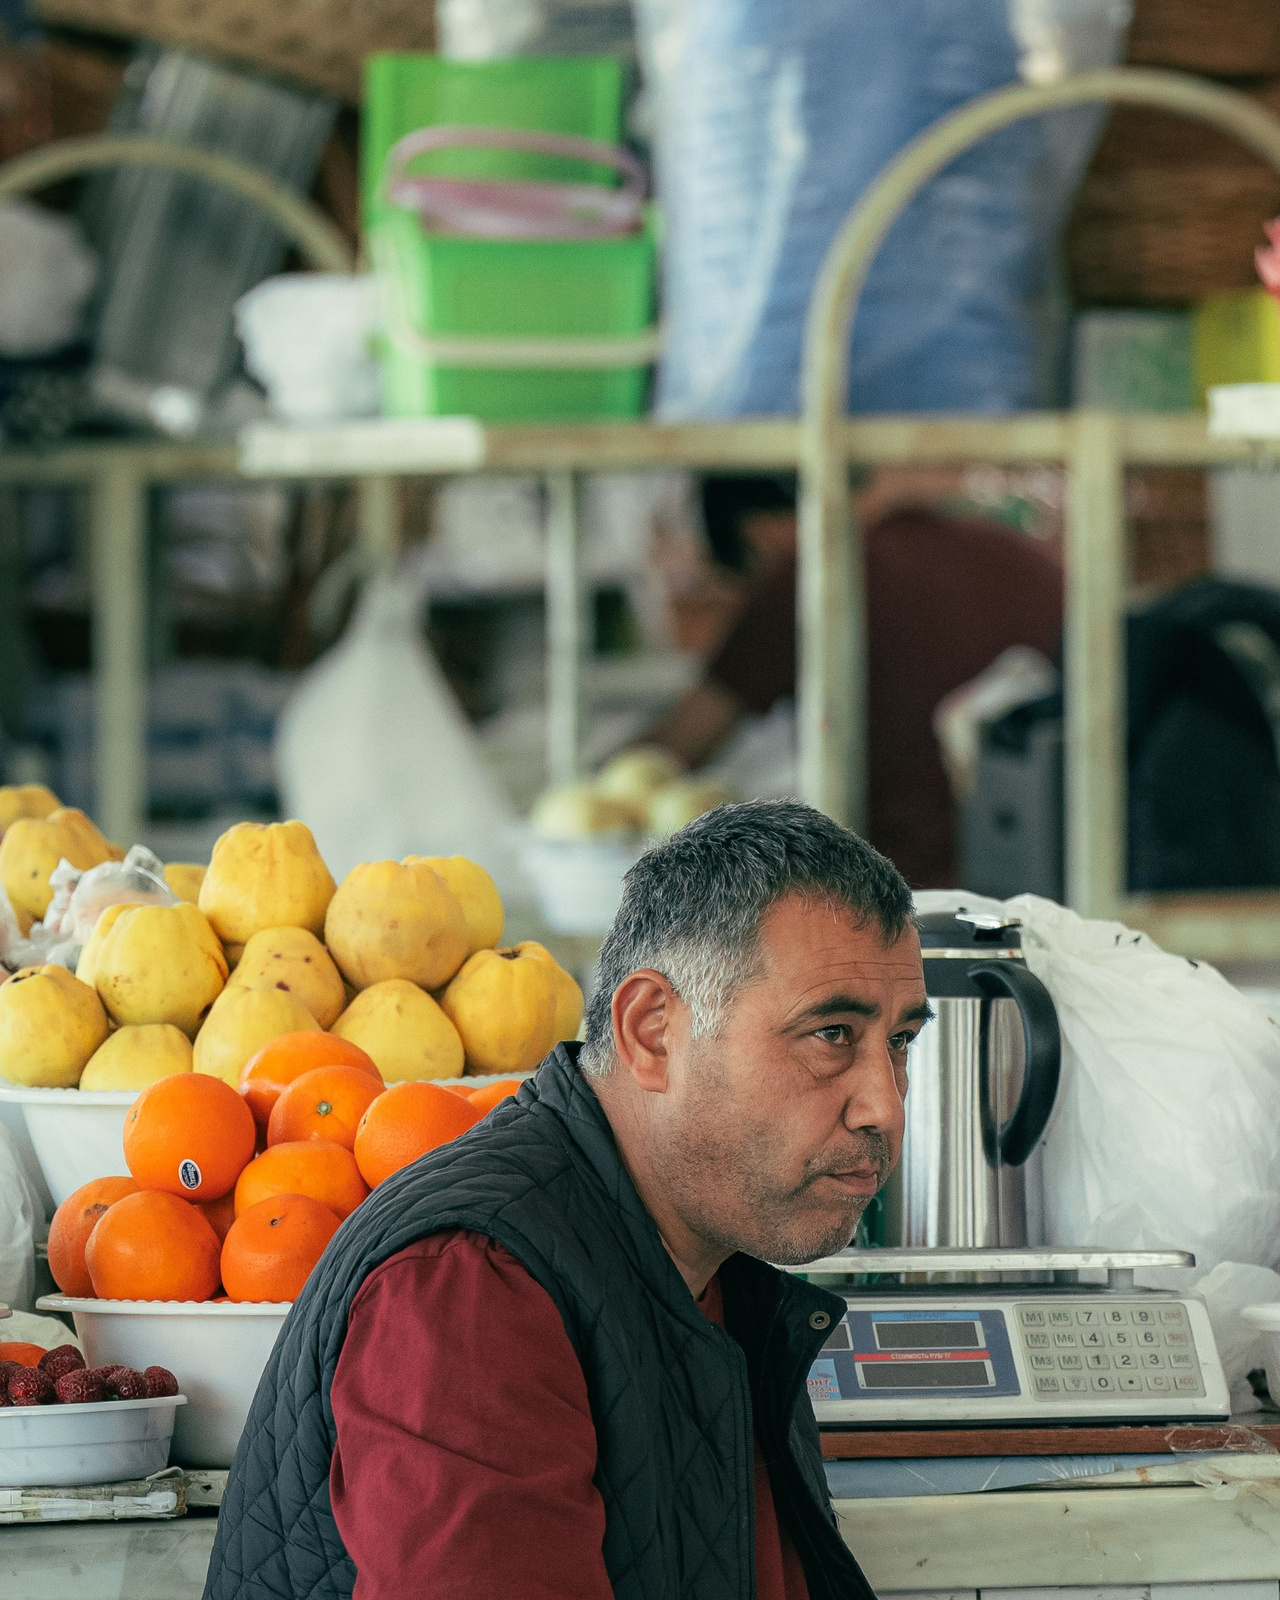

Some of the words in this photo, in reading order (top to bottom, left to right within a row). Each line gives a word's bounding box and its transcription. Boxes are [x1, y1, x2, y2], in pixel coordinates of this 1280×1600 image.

[1026, 1312, 1042, 1323] M1
[1052, 1311, 1069, 1322] M5
[1083, 1311, 1093, 1322] 7
[1111, 1311, 1122, 1322] 8
[1138, 1311, 1149, 1322] 9
[1030, 1333, 1047, 1344] M2
[1056, 1333, 1074, 1344] M6
[1088, 1332, 1099, 1343] 4
[1116, 1332, 1127, 1343] 5
[1143, 1332, 1154, 1343] 6
[1034, 1355, 1051, 1366] M3
[1061, 1355, 1079, 1366] M7
[1092, 1355, 1101, 1366] 1
[1120, 1355, 1132, 1366] 2
[1148, 1354, 1160, 1365] 3
[1039, 1377, 1057, 1388] M4
[1153, 1377, 1164, 1387] C
